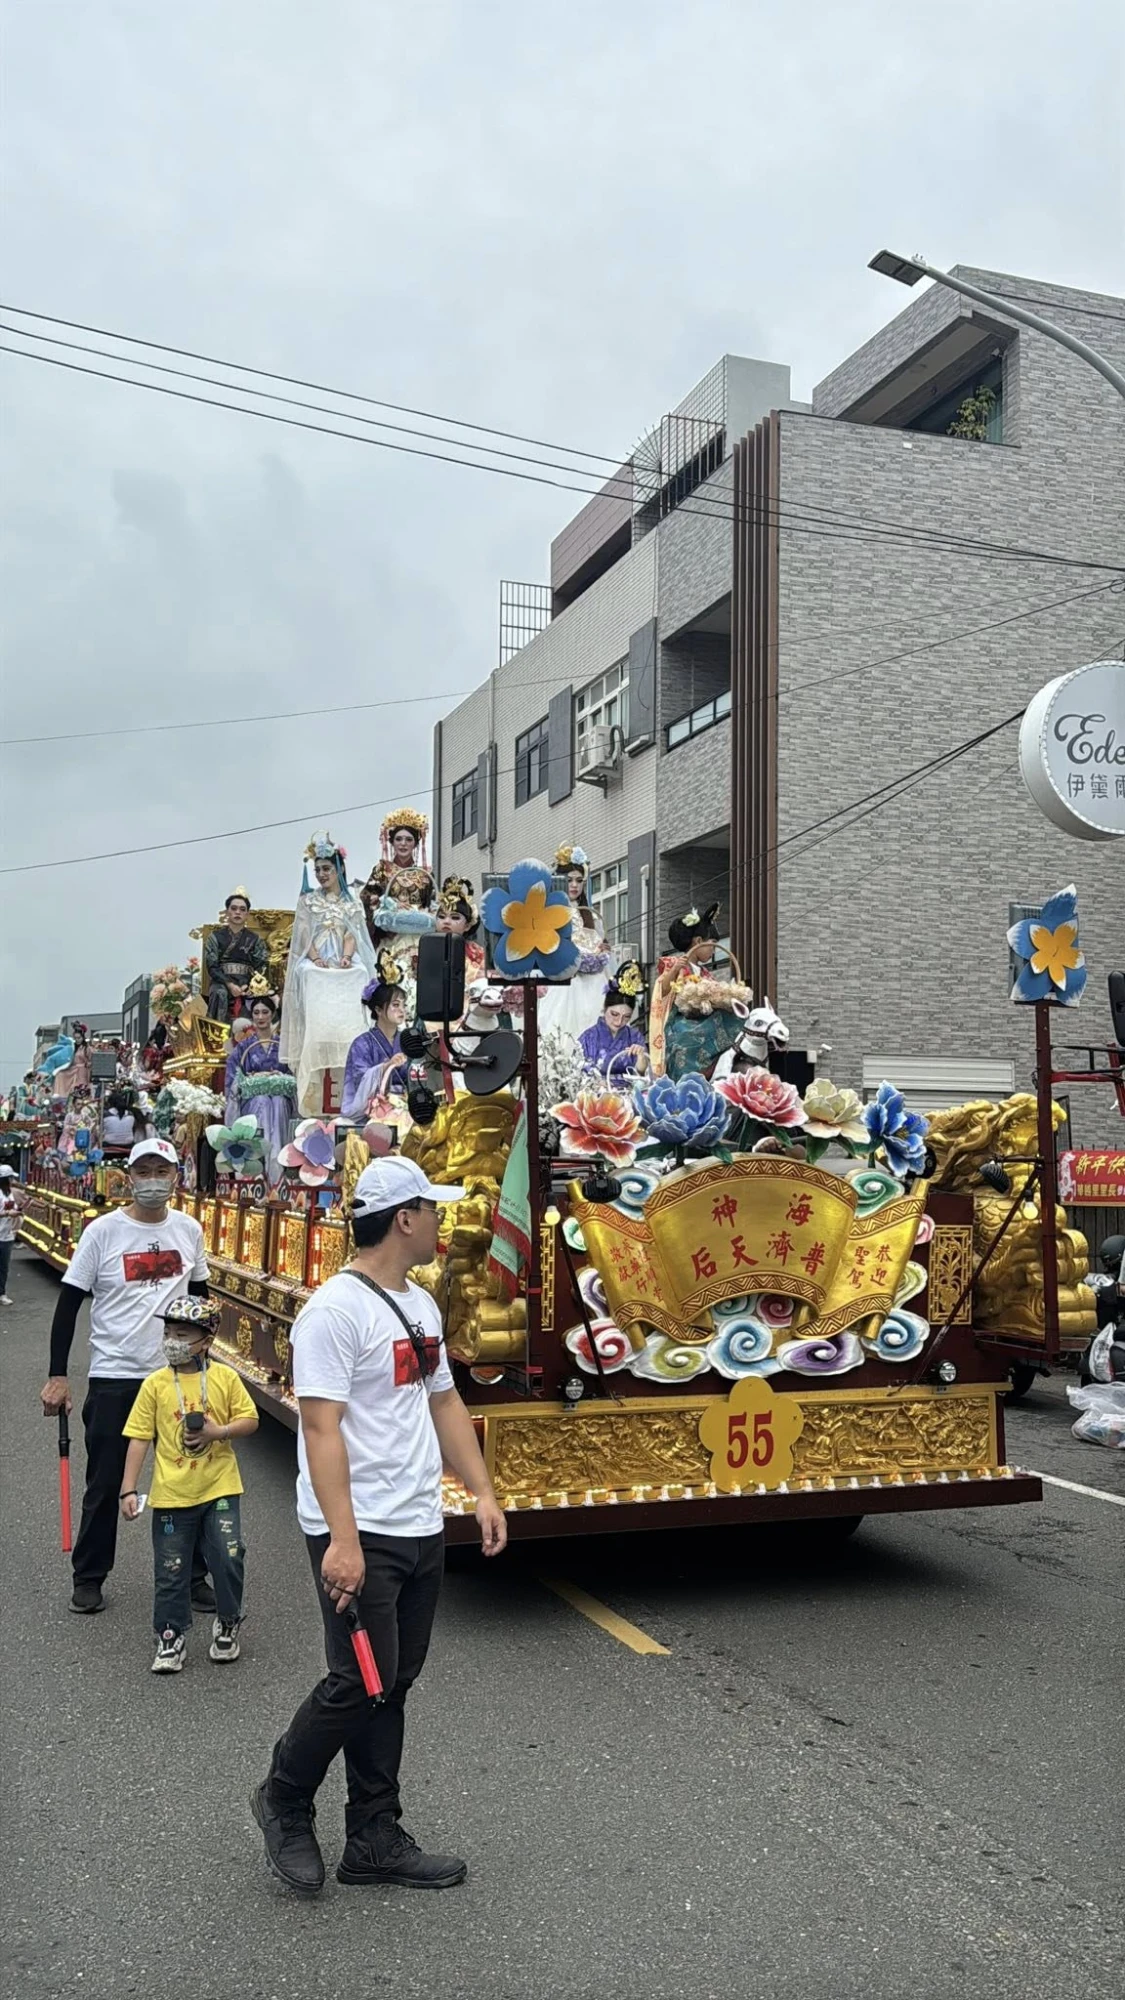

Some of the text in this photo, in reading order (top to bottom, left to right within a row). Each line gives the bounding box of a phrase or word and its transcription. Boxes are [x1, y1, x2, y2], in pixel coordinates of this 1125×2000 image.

[1054, 714, 1125, 765] Ede
[870, 1244, 893, 1286] 恭迎
[727, 1410, 774, 1468] 55
